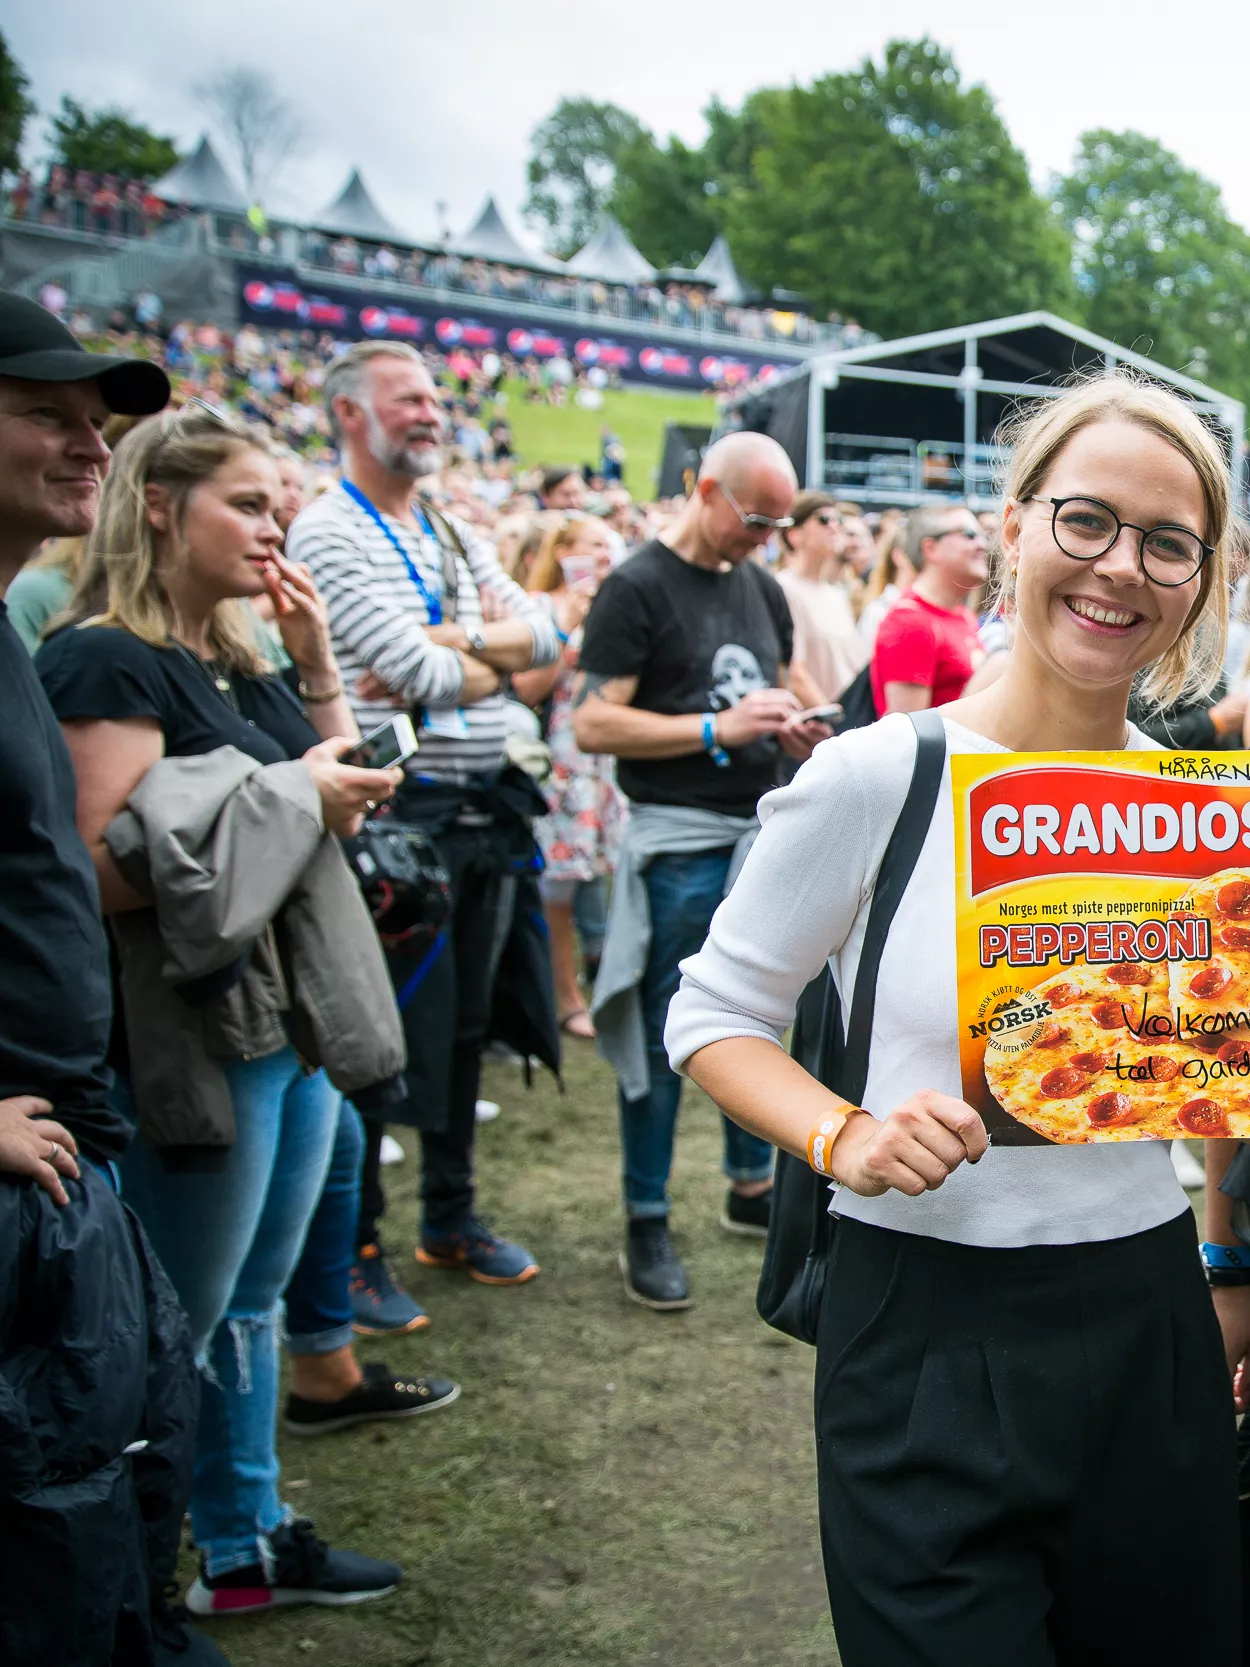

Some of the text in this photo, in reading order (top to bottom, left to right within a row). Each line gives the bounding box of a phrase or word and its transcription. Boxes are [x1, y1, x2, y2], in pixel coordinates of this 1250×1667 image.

[999, 897, 1195, 918] Norges mest spiste pepperonipizza!
[980, 919, 1210, 966] PEPPERONI
[968, 1001, 1053, 1039] NORSK
[984, 1036, 1002, 1052] PIZZA
[1003, 1045, 1019, 1053] UTEN
